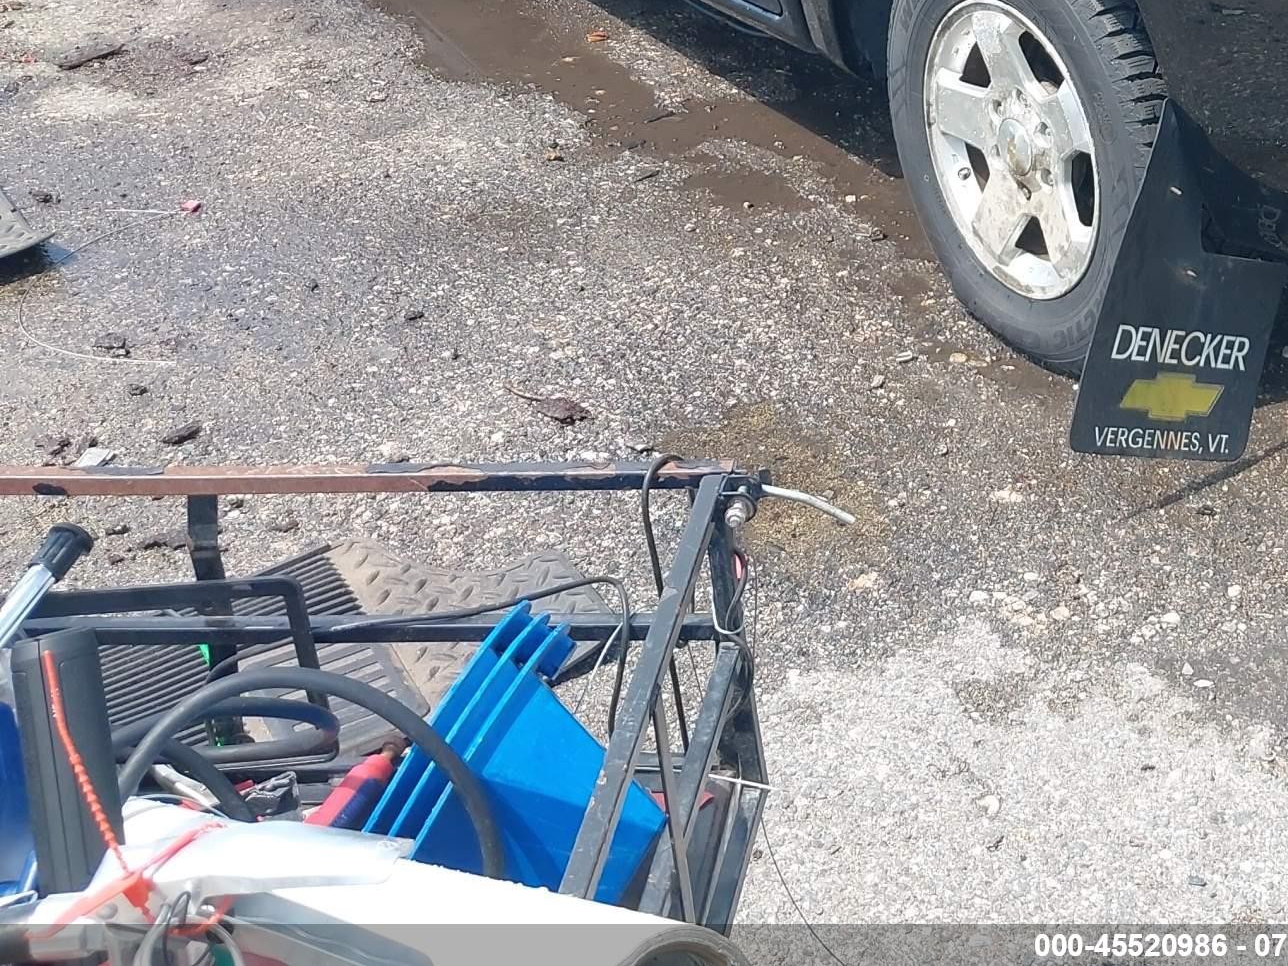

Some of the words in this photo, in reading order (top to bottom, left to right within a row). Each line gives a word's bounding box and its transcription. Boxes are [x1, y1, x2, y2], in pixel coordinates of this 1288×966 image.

[1110, 324, 1251, 372] DENECKER
[1094, 426, 1204, 455] VERGENNES,
[1208, 433, 1230, 454] VT.
